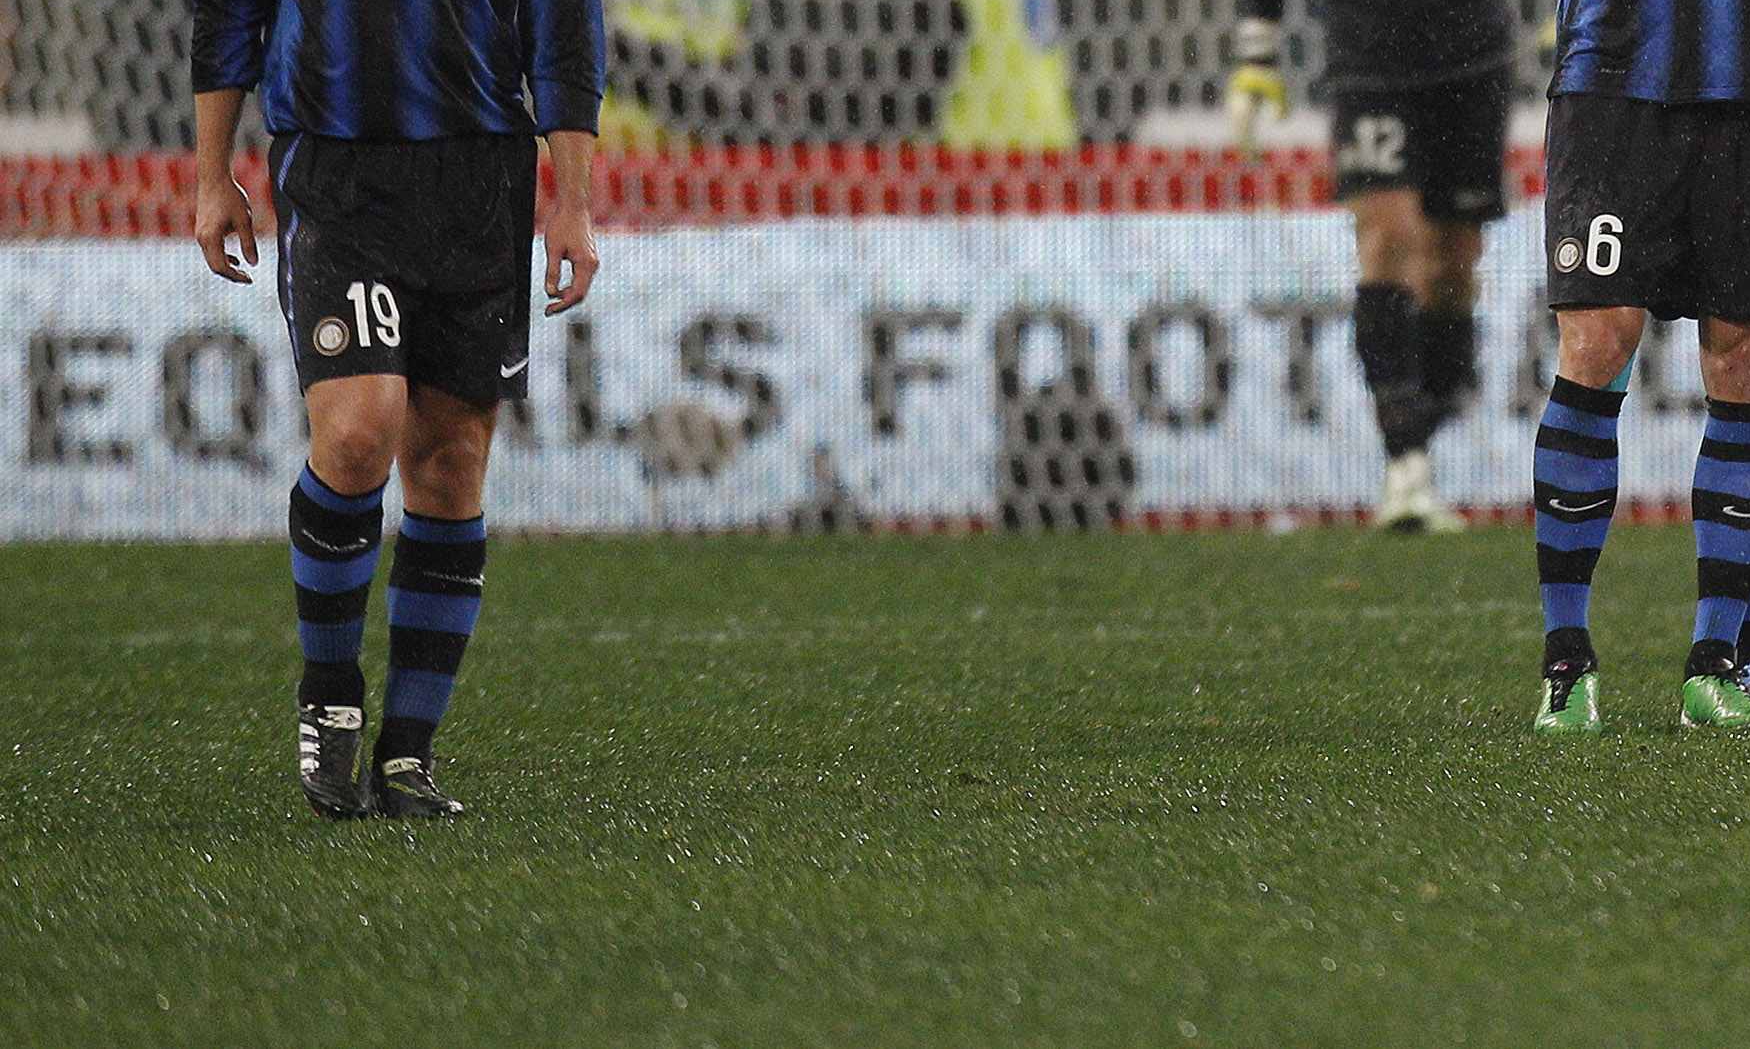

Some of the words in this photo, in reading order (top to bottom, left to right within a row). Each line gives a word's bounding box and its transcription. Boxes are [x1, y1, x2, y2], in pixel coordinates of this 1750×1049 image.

[1586, 214, 1624, 276] 6
[346, 280, 401, 347] 19
[25, 307, 784, 475] EQLS
